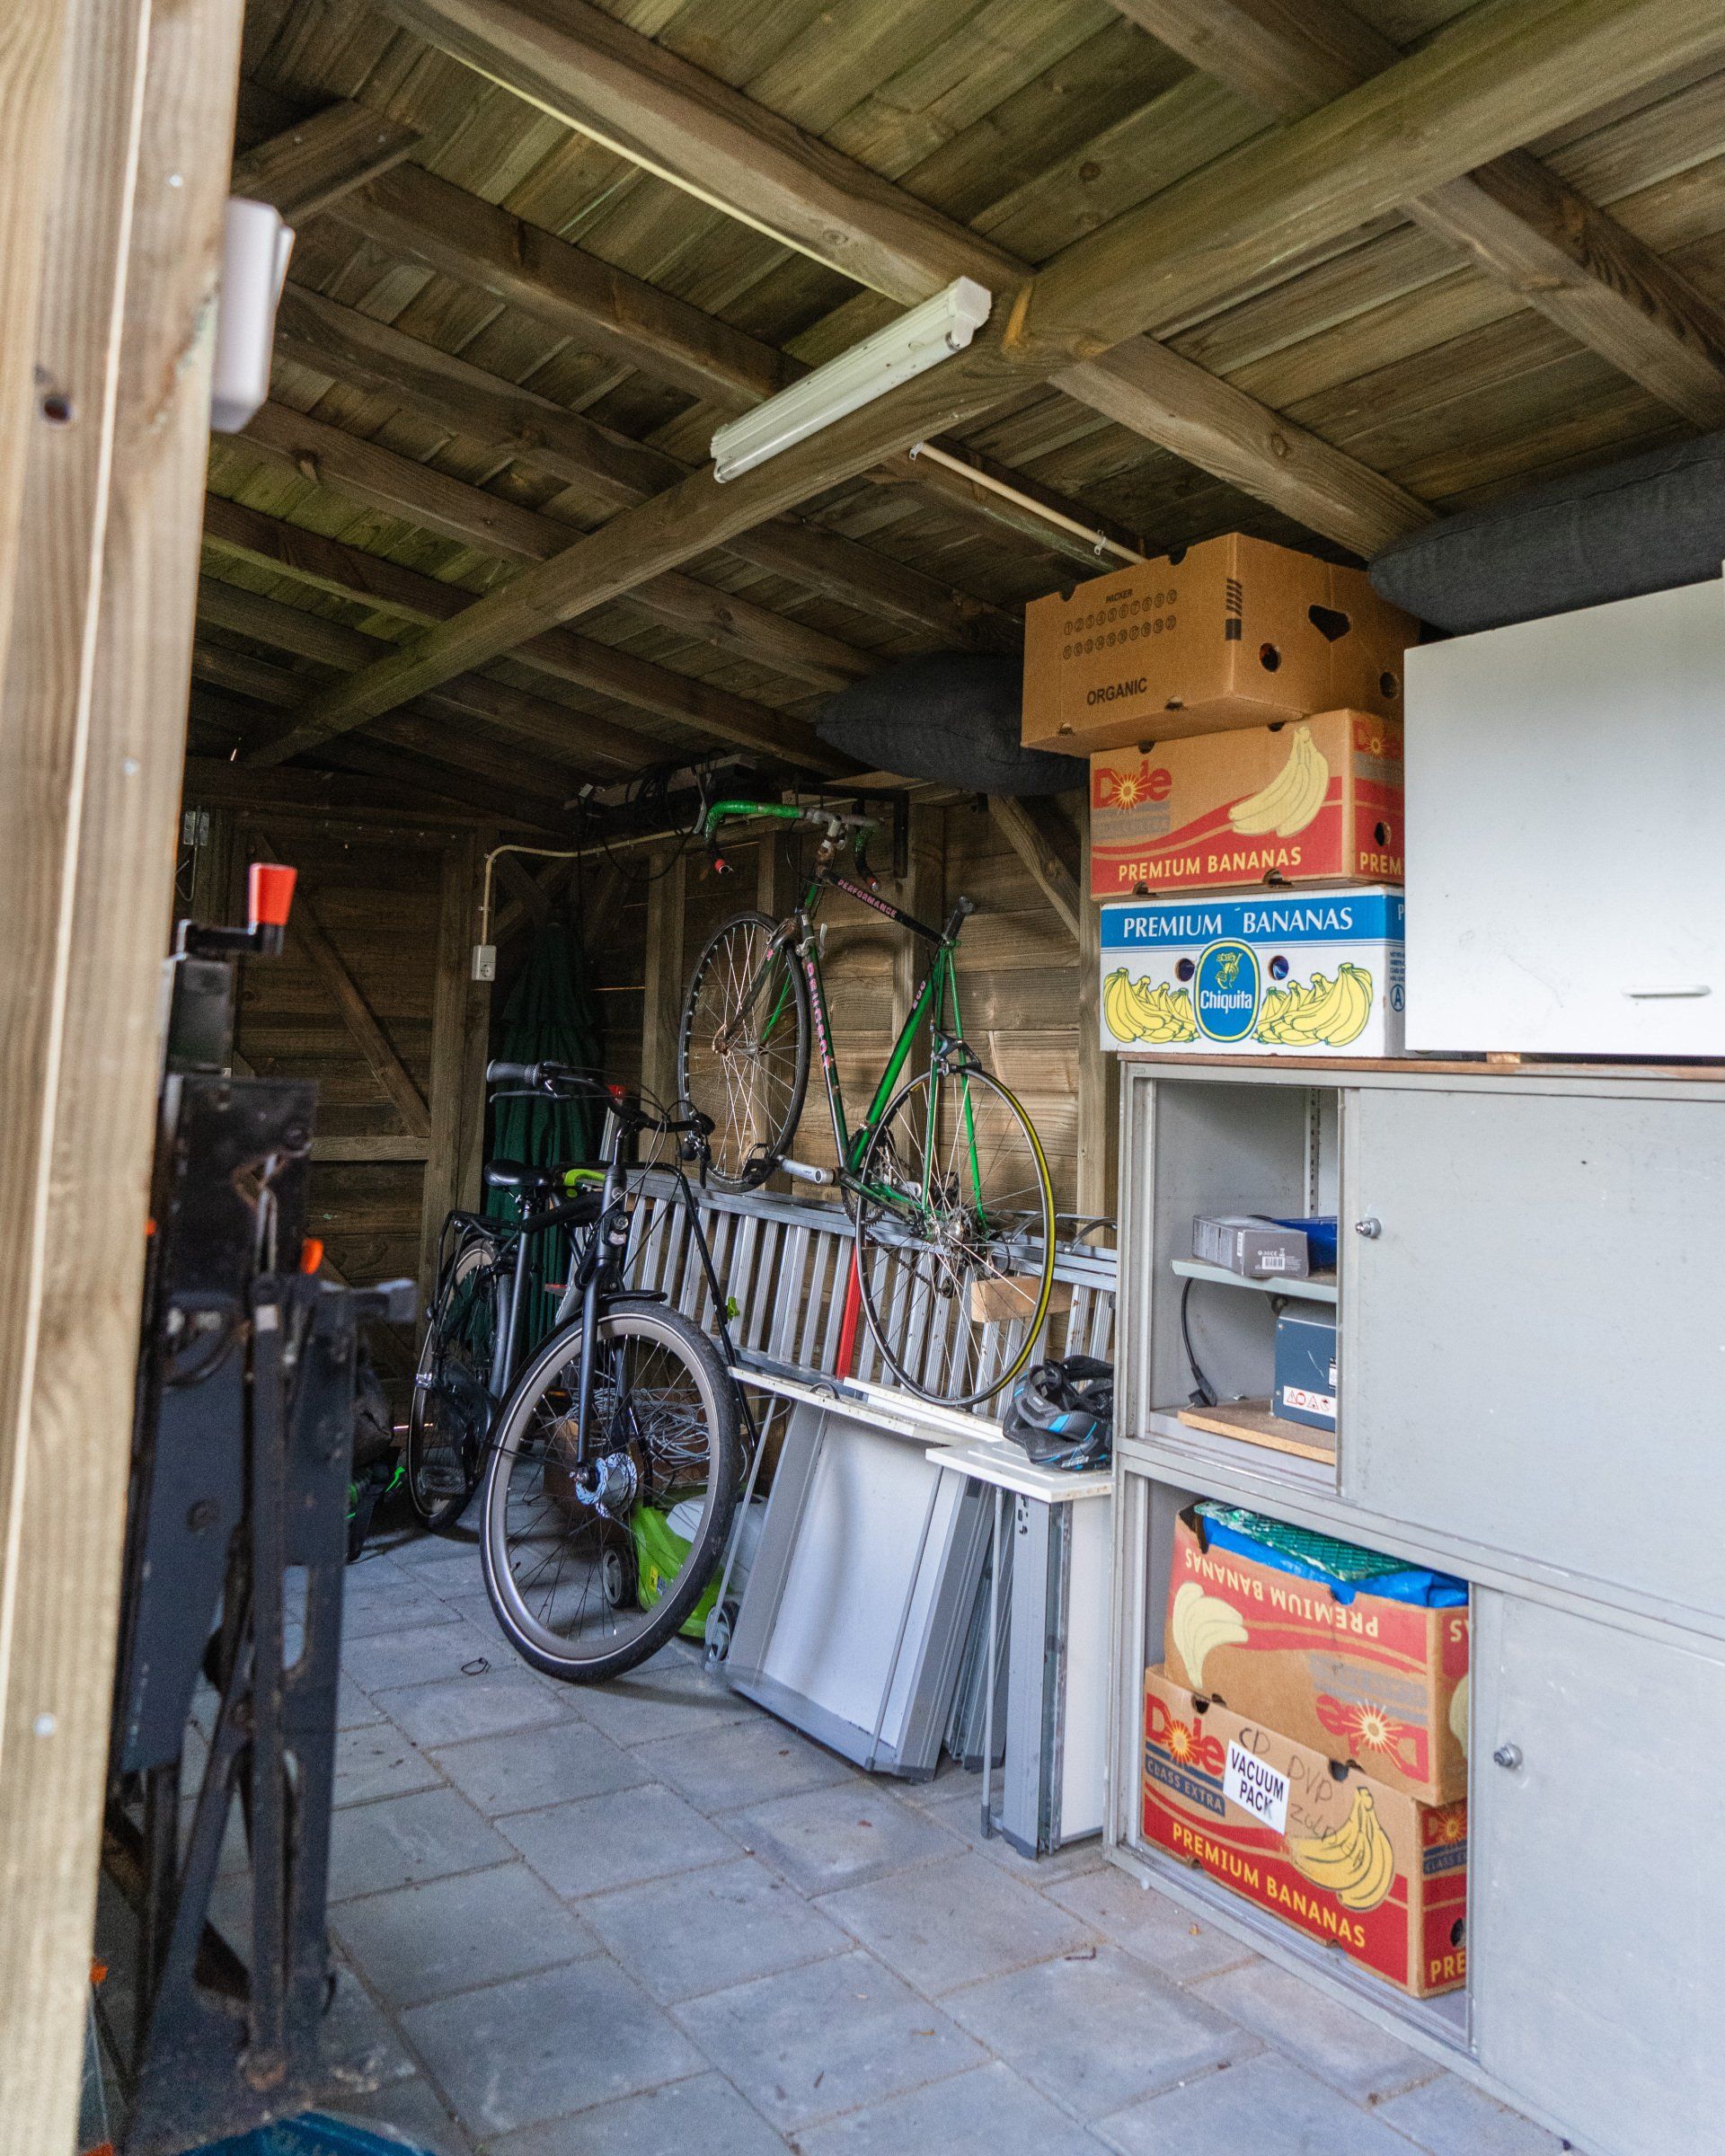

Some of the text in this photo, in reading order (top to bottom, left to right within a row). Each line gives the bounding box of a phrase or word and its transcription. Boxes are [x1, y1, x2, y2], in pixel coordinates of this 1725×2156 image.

[1086, 677, 1148, 705] ORGANIC
[1093, 760, 1172, 810] Dole
[1119, 846, 1302, 882] PREMIUM BANANAS
[837, 879, 897, 918] PERFORMANCE
[1124, 906, 1353, 938] PREMIUM BANANAS
[1200, 989, 1252, 1014] Chiquita
[1185, 1548, 1379, 1638] PREMIUM BANANAS
[1146, 1692, 1225, 1776] Dole
[1147, 1759, 1222, 1812] CLASS EXTRA
[1232, 1747, 1284, 1802] VACUUM
[1287, 1754, 1333, 1803] DVD
[1240, 1780, 1273, 1819] PACK
[1172, 1822, 1366, 1948] PREMIUM BANANAS
